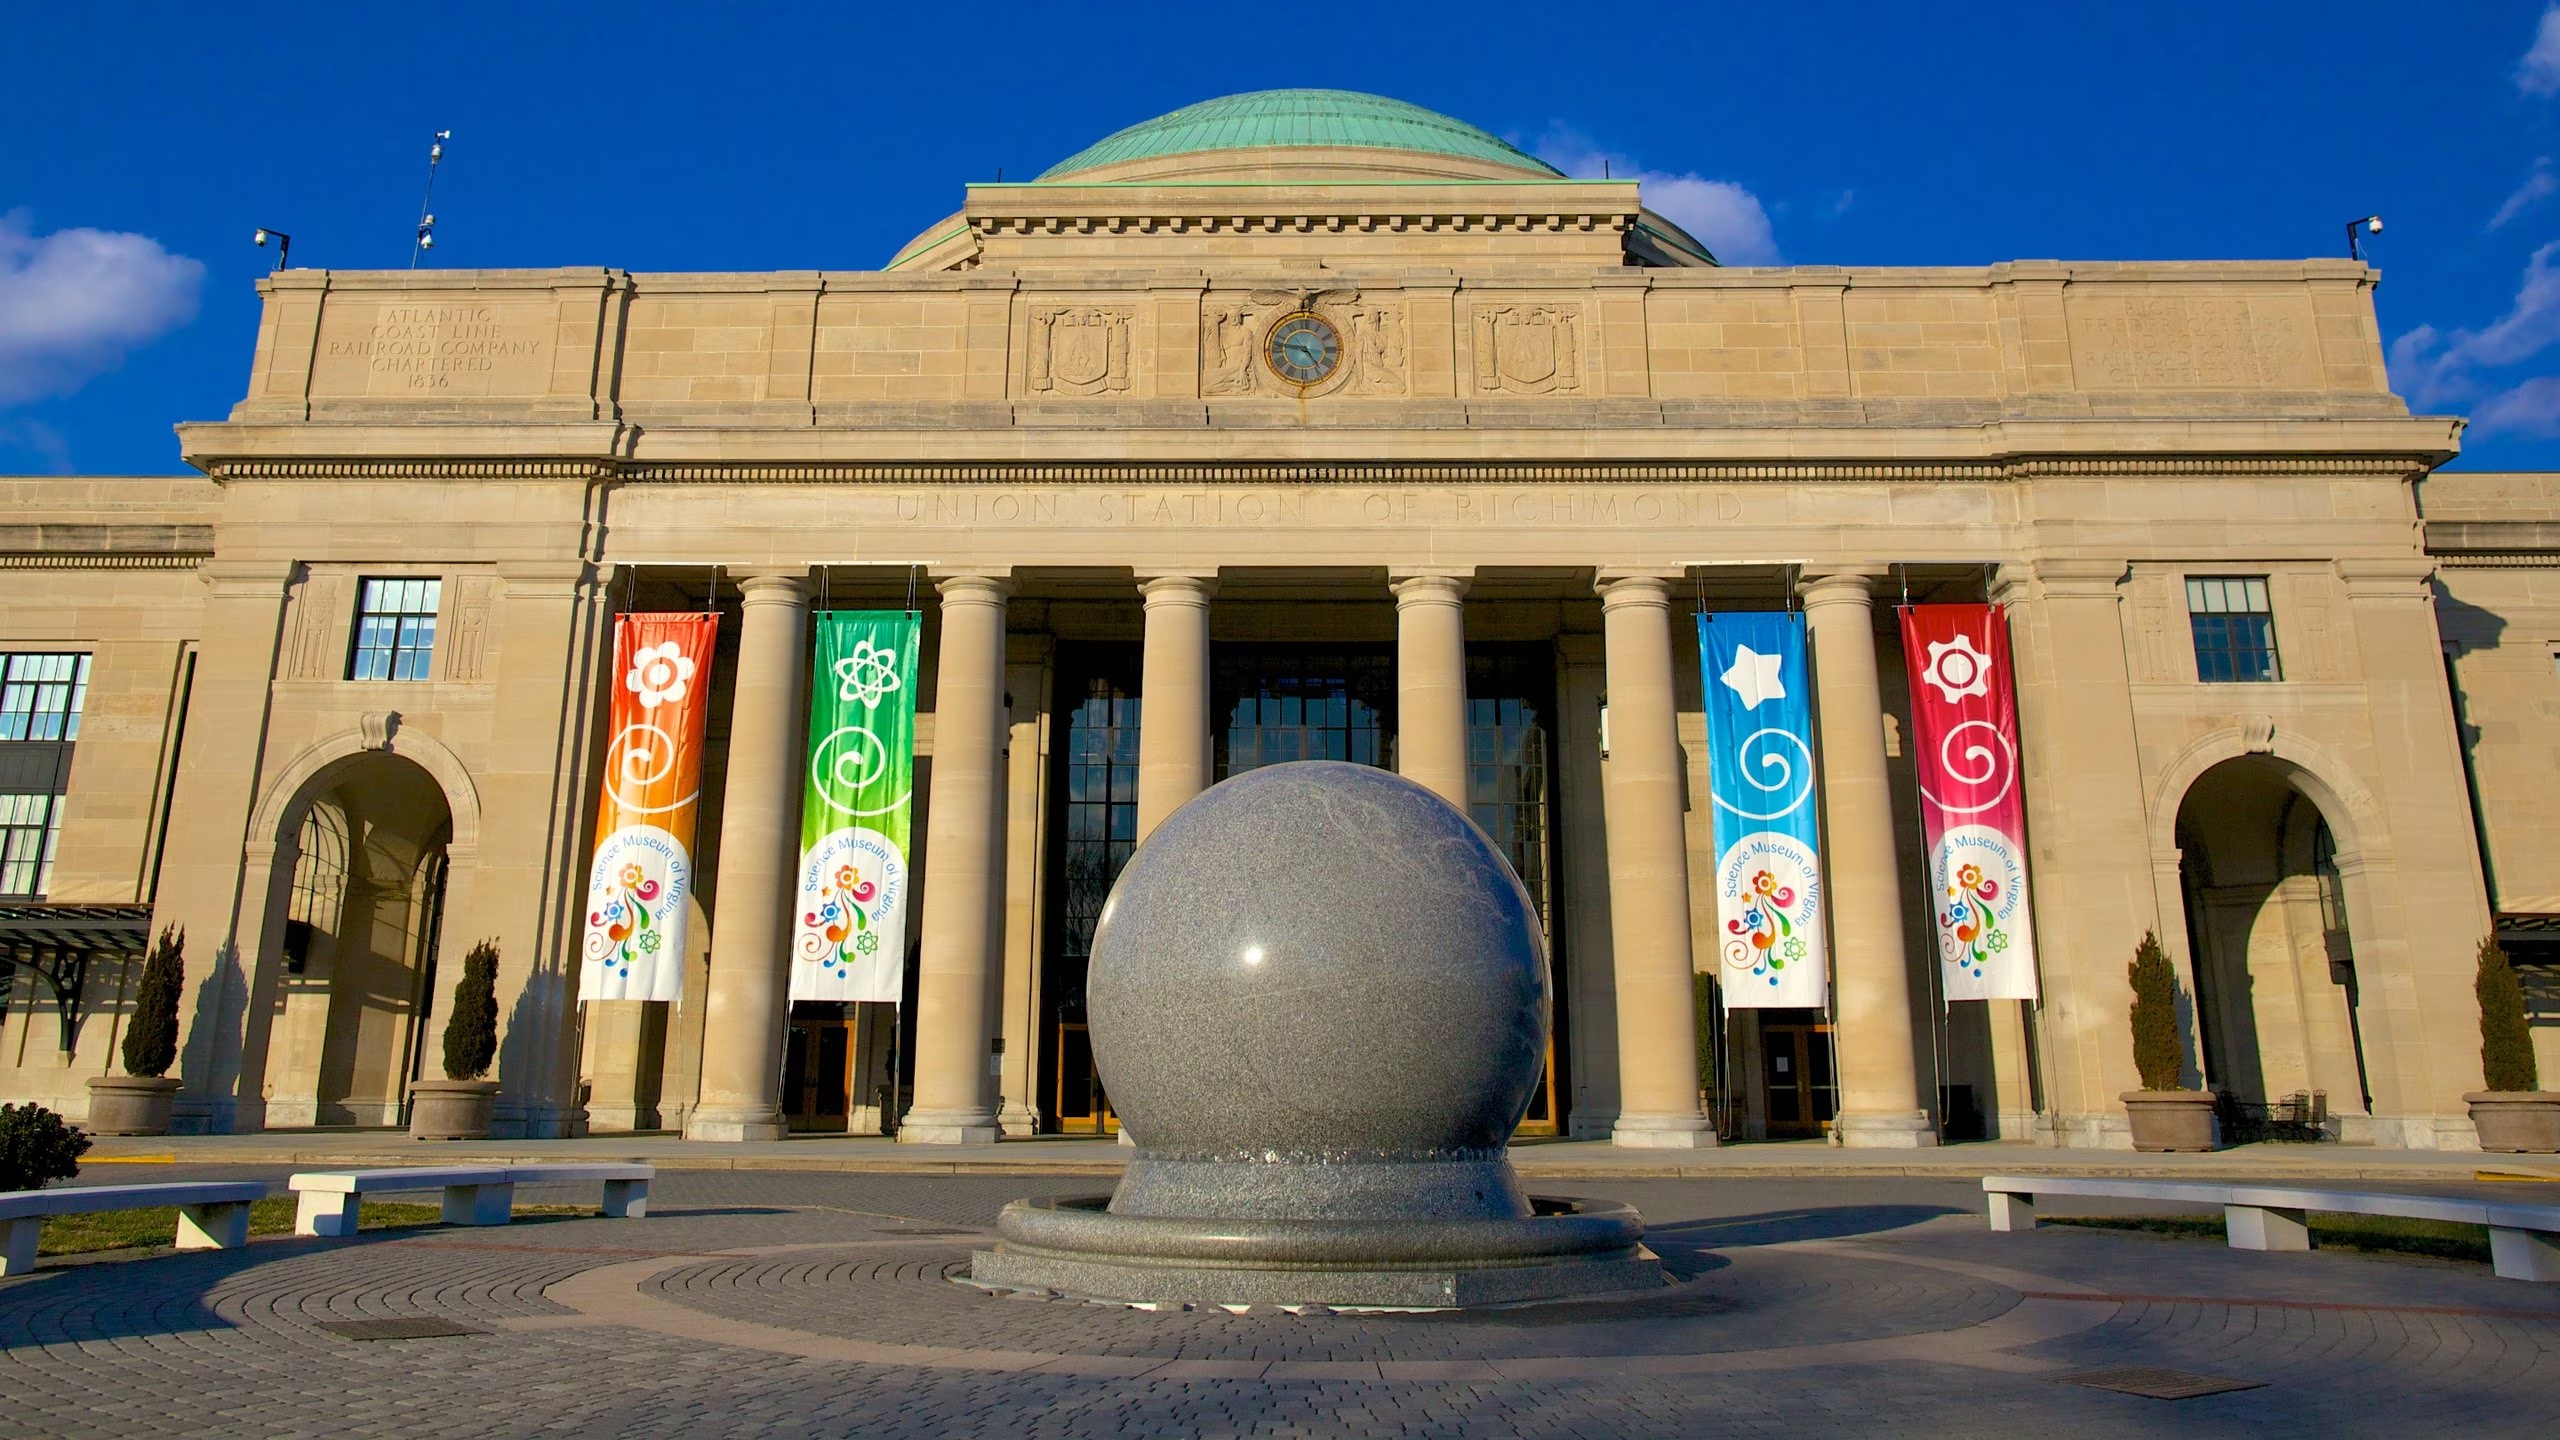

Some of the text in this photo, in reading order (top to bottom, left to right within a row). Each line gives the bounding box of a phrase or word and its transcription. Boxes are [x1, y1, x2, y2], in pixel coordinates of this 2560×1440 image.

[386, 308, 491, 323] ATLANTIC
[2125, 301, 2249, 316] RICHOD
[371, 325, 502, 339] COAST LINE
[329, 341, 540, 356] RAILROAD COMPANY
[372, 357, 493, 372] CHARTERED
[408, 373, 449, 389] 1836
[895, 493, 1744, 522] UNION STATION OF RICHMOND
[593, 835, 686, 921] Science Museum of Virginia
[805, 836, 901, 922] Science Museum of Virginia
[1725, 841, 1820, 928] Science Museum of Virginia
[1937, 835, 2022, 921] Science Museum of Virginia
